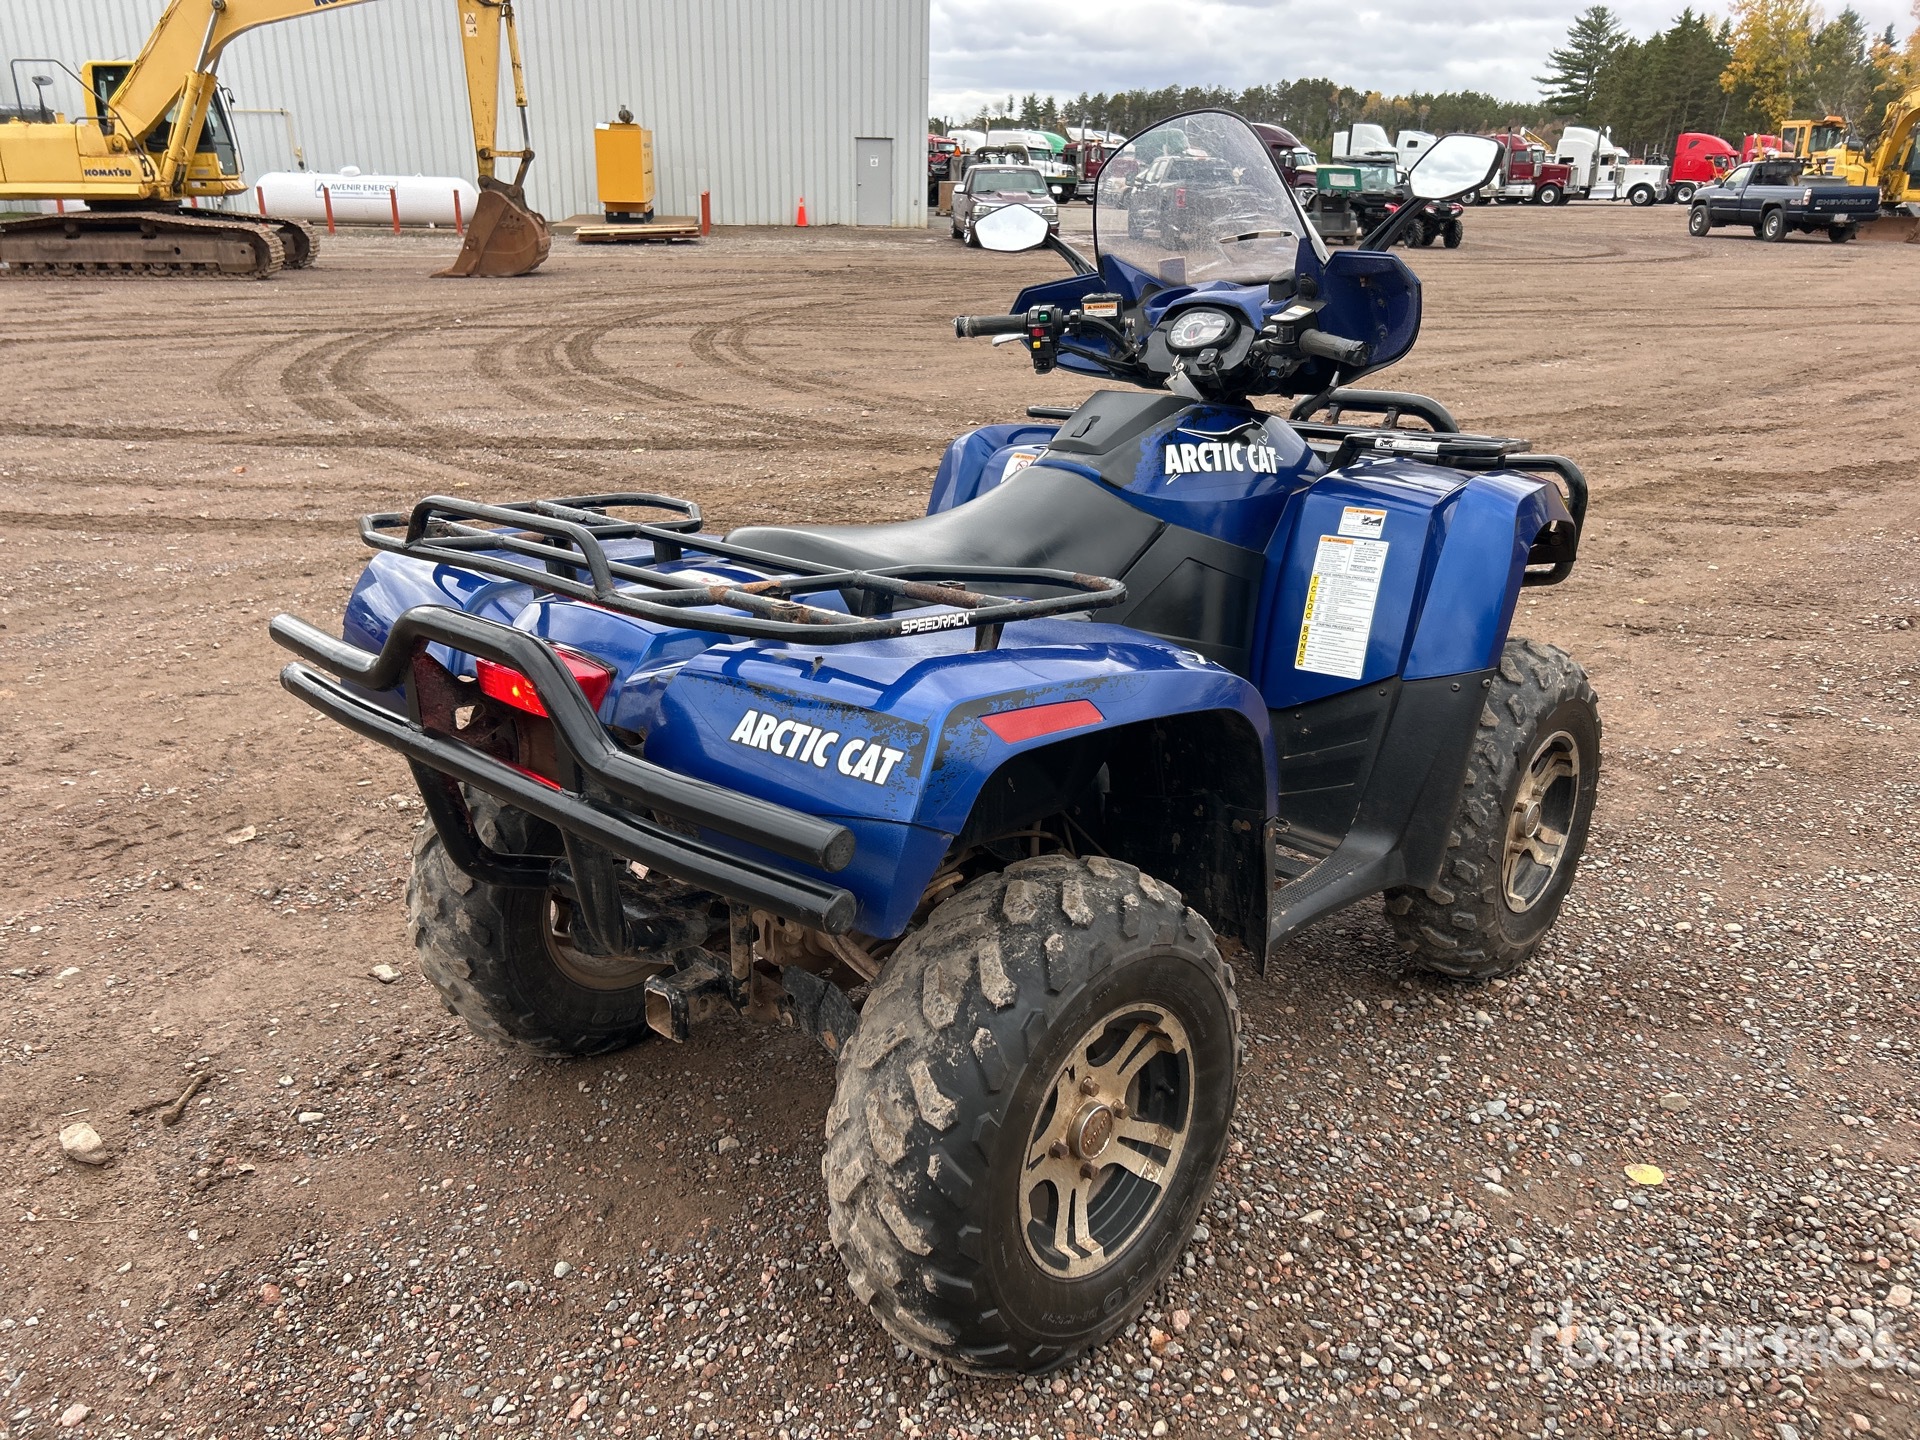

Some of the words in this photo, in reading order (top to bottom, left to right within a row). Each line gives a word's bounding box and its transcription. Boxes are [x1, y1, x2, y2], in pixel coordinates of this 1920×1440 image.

[84, 167, 132, 177] KOMATSU
[330, 183, 362, 191] AVENIR
[1815, 198, 1872, 206] CHEVROLET
[1164, 442, 1245, 475] ARCTIC
[1246, 443, 1278, 475] CAT
[900, 613, 970, 635] SPEEDRACK
[730, 709, 840, 768] ARCTIC
[837, 739, 905, 785] CAT
